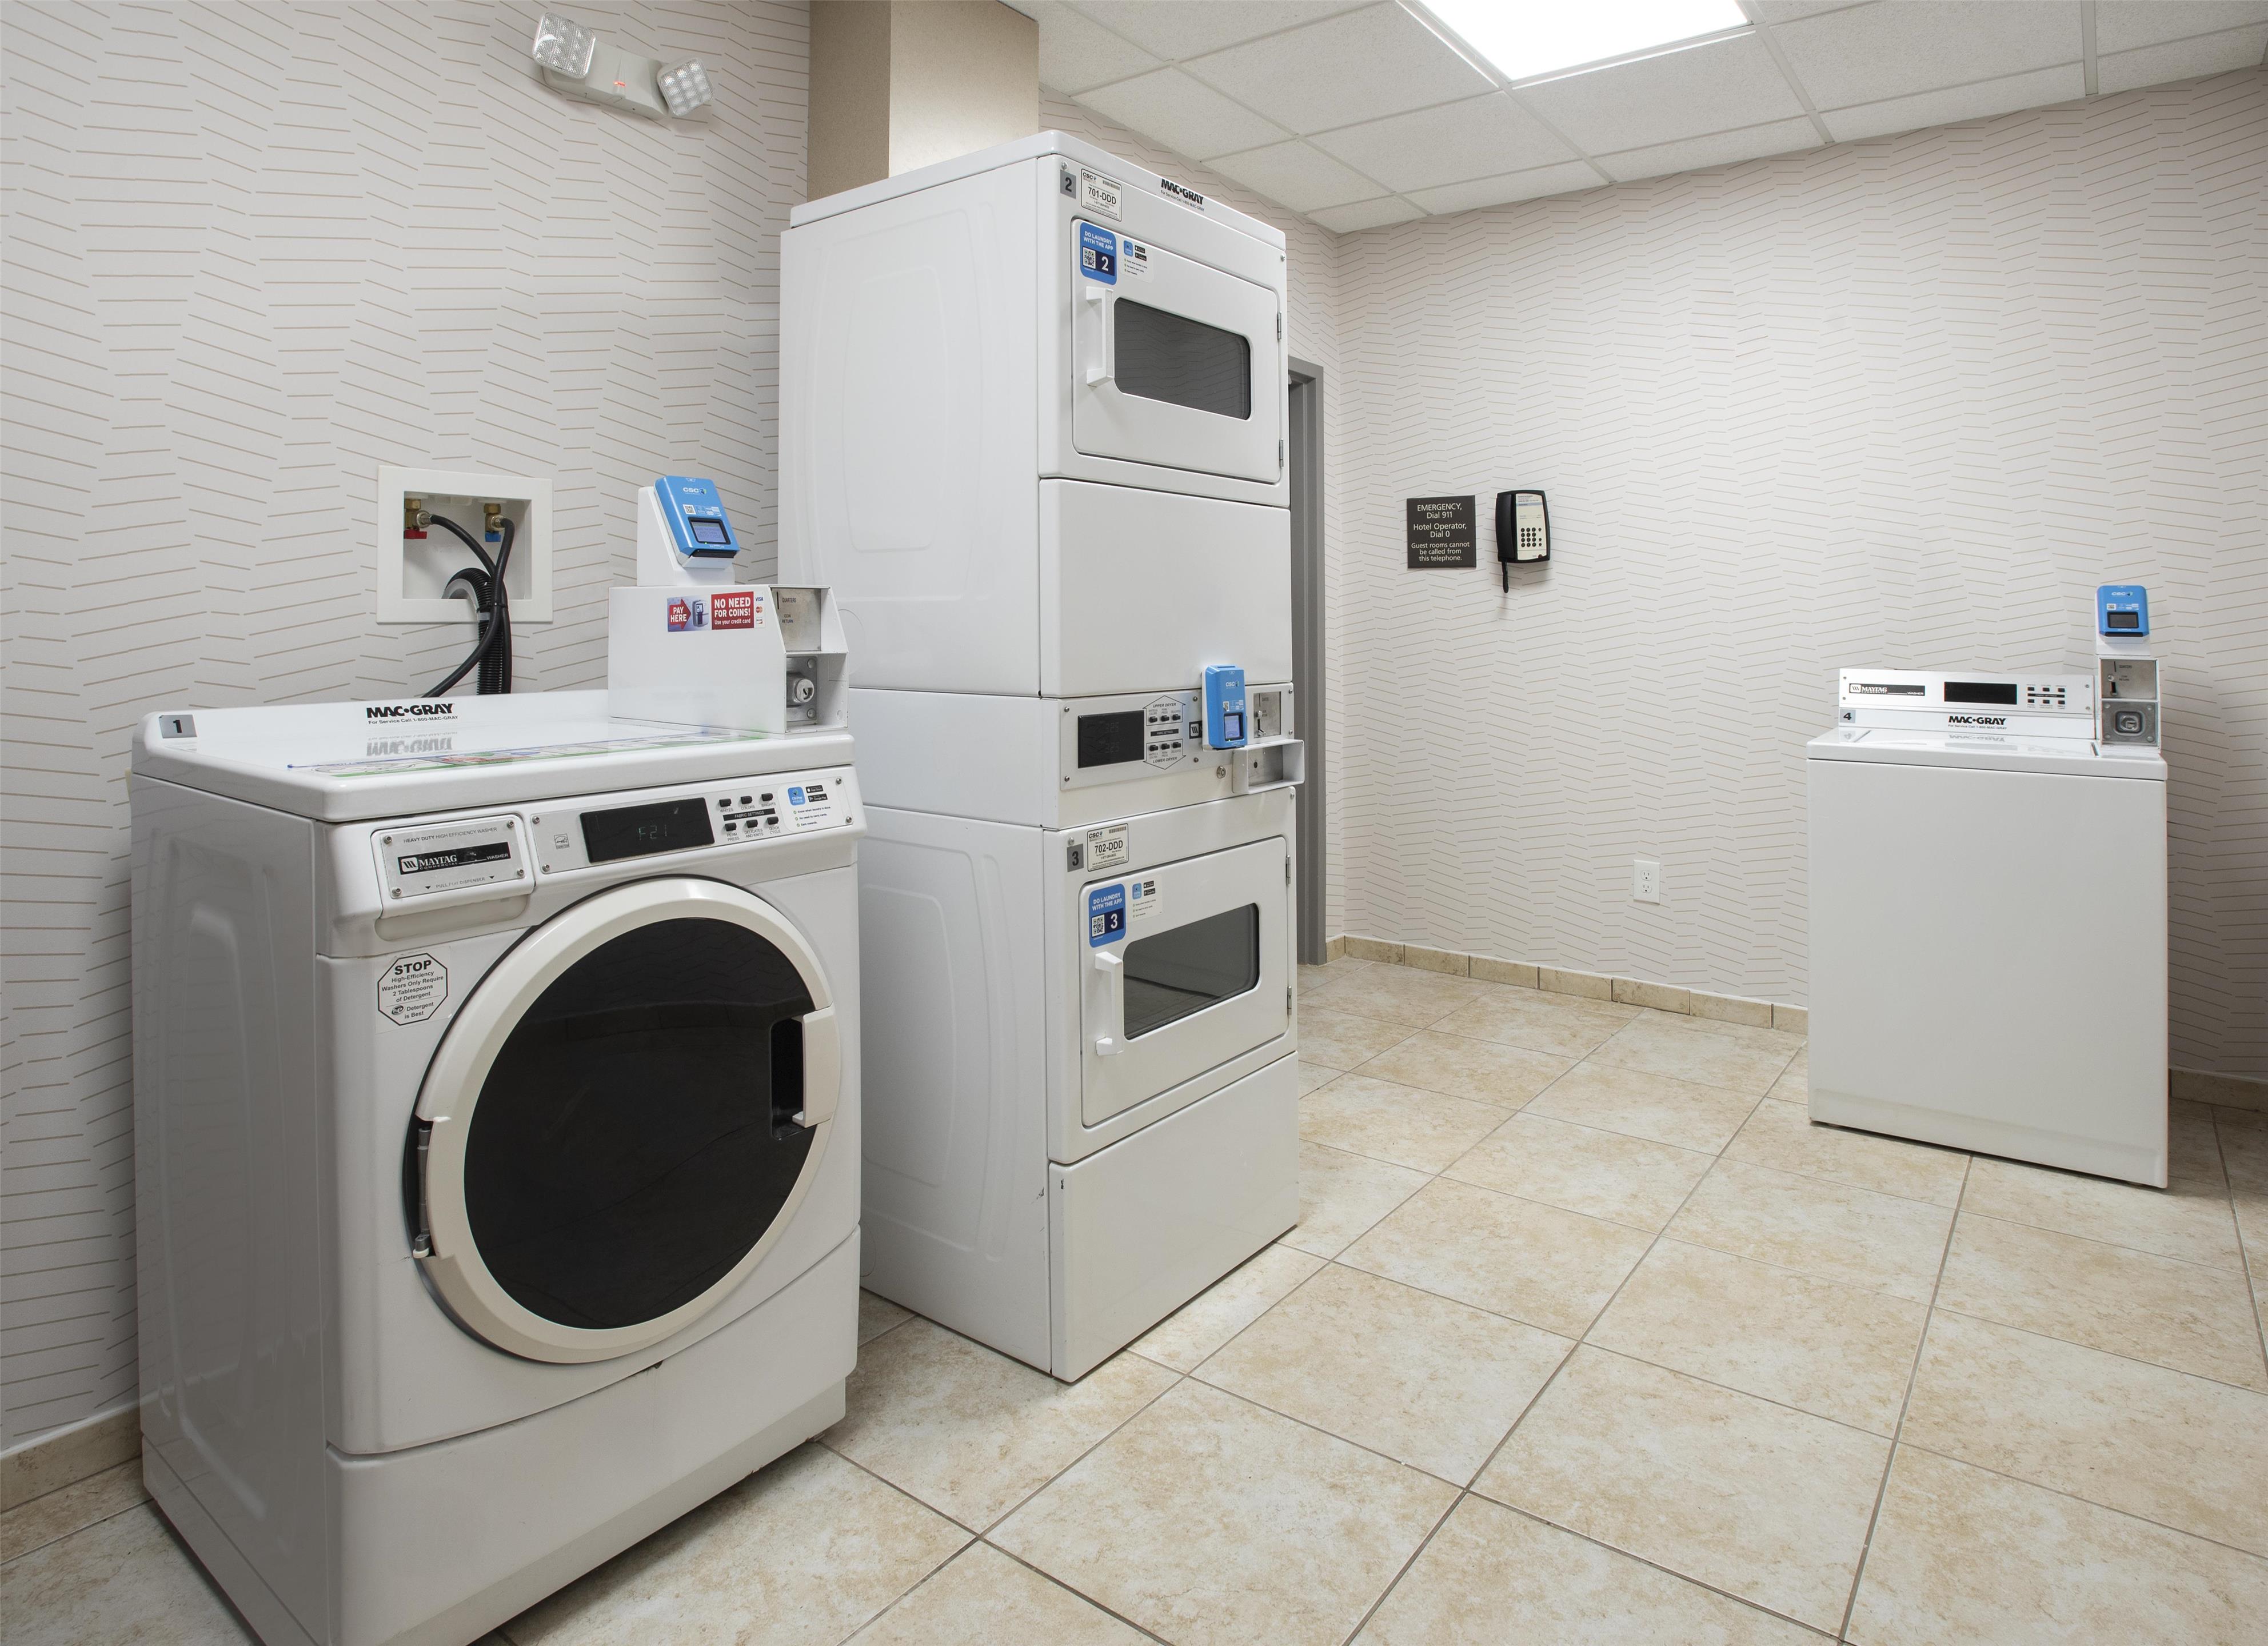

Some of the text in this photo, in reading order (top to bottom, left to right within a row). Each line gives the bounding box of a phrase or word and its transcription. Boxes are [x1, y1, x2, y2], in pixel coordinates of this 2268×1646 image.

[1083, 172, 1093, 180] CSC
[1065, 177, 1072, 192] 2
[1088, 187, 1116, 204] 701-DDD
[1084, 236, 1095, 245] WITH
[1092, 233, 1112, 244] LAUNDRY
[1101, 256, 1108, 271] 2
[1418, 503, 1462, 511] EMERGENCY,
[1434, 522, 1467, 531] Operator,
[714, 597, 750, 609] NO NEED
[673, 606, 684, 614] PAY
[729, 608, 750, 617] COINS!
[670, 614, 687, 622] HERE
[1843, 712, 1852, 720] 4
[173, 720, 182, 733] 1
[1095, 840, 1123, 854] 702-DDD
[419, 854, 457, 867] MAYTAG
[1072, 851, 1079, 866] 3
[1101, 892, 1120, 902] LAUNDRY
[1092, 903, 1104, 911] WITH
[1111, 913, 1118, 929] 3
[394, 960, 432, 975] STOP
[392, 971, 434, 982] High-Efficiency
[381, 983, 406, 992] Washers
[422, 976, 444, 984] Require
[398, 985, 433, 996] Tablespoons
[404, 992, 430, 1001] Detergent
[406, 1002, 434, 1012] Detergent
